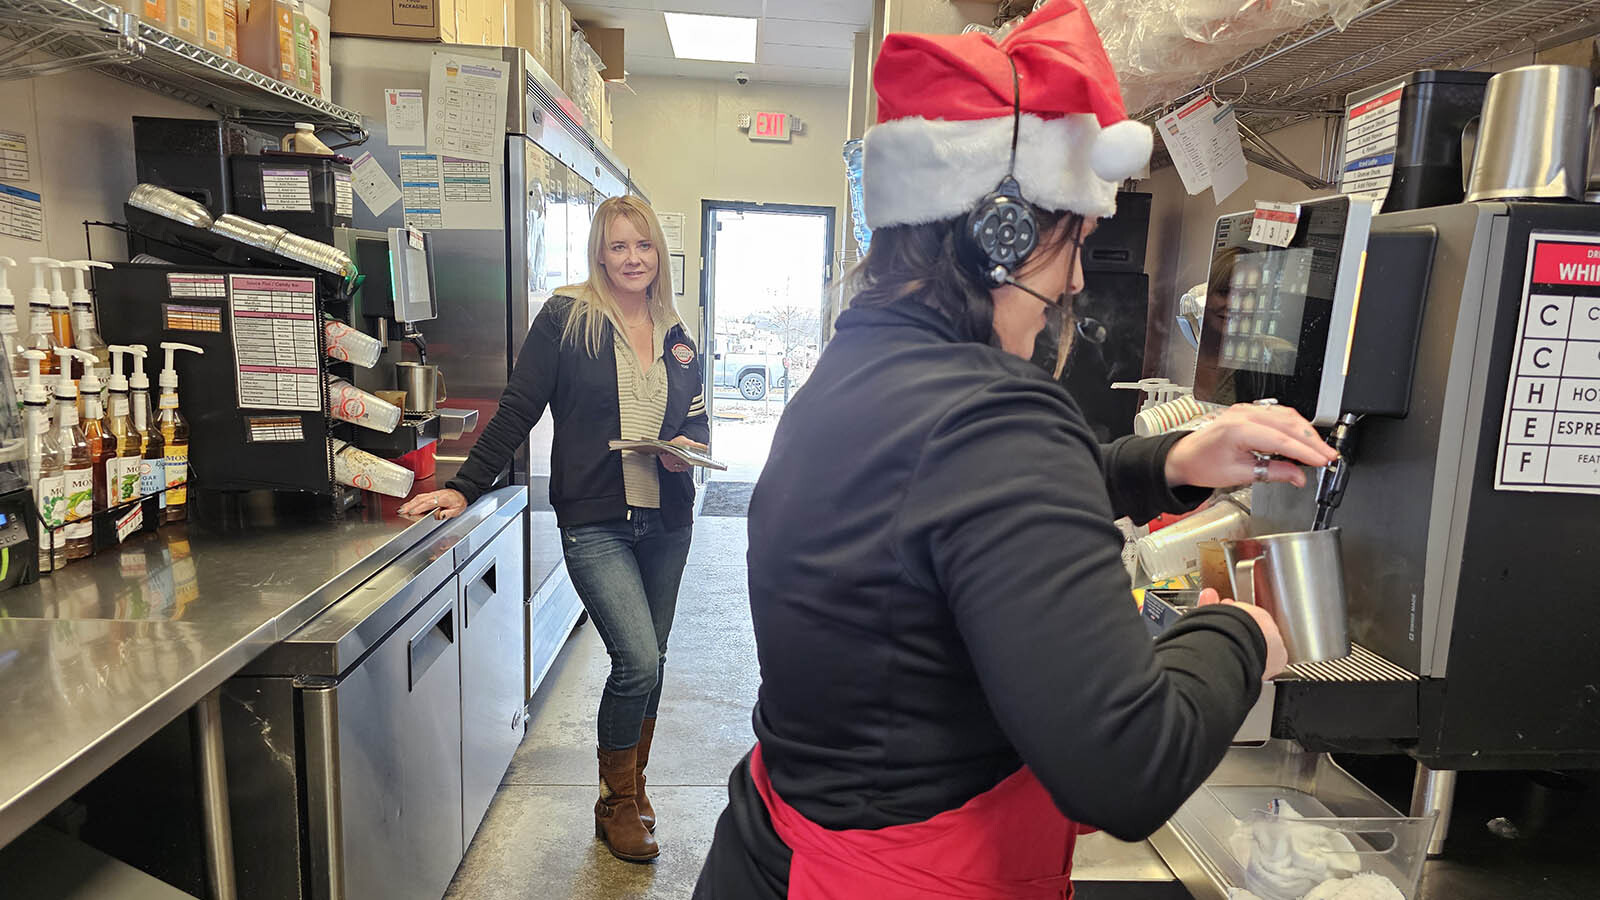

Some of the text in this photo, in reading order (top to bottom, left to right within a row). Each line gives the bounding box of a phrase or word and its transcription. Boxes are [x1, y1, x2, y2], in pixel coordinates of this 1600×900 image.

[756, 112, 788, 137] EXIT
[1540, 305, 1560, 326] C
[1533, 347, 1553, 369] C
[1528, 383, 1544, 404] H
[1573, 387, 1600, 402] HO
[1524, 417, 1538, 438] E
[1557, 421, 1600, 436] ESPRE
[1520, 452, 1532, 473] F
[142, 475, 157, 483] GAR
[140, 486, 160, 494] NILLA
